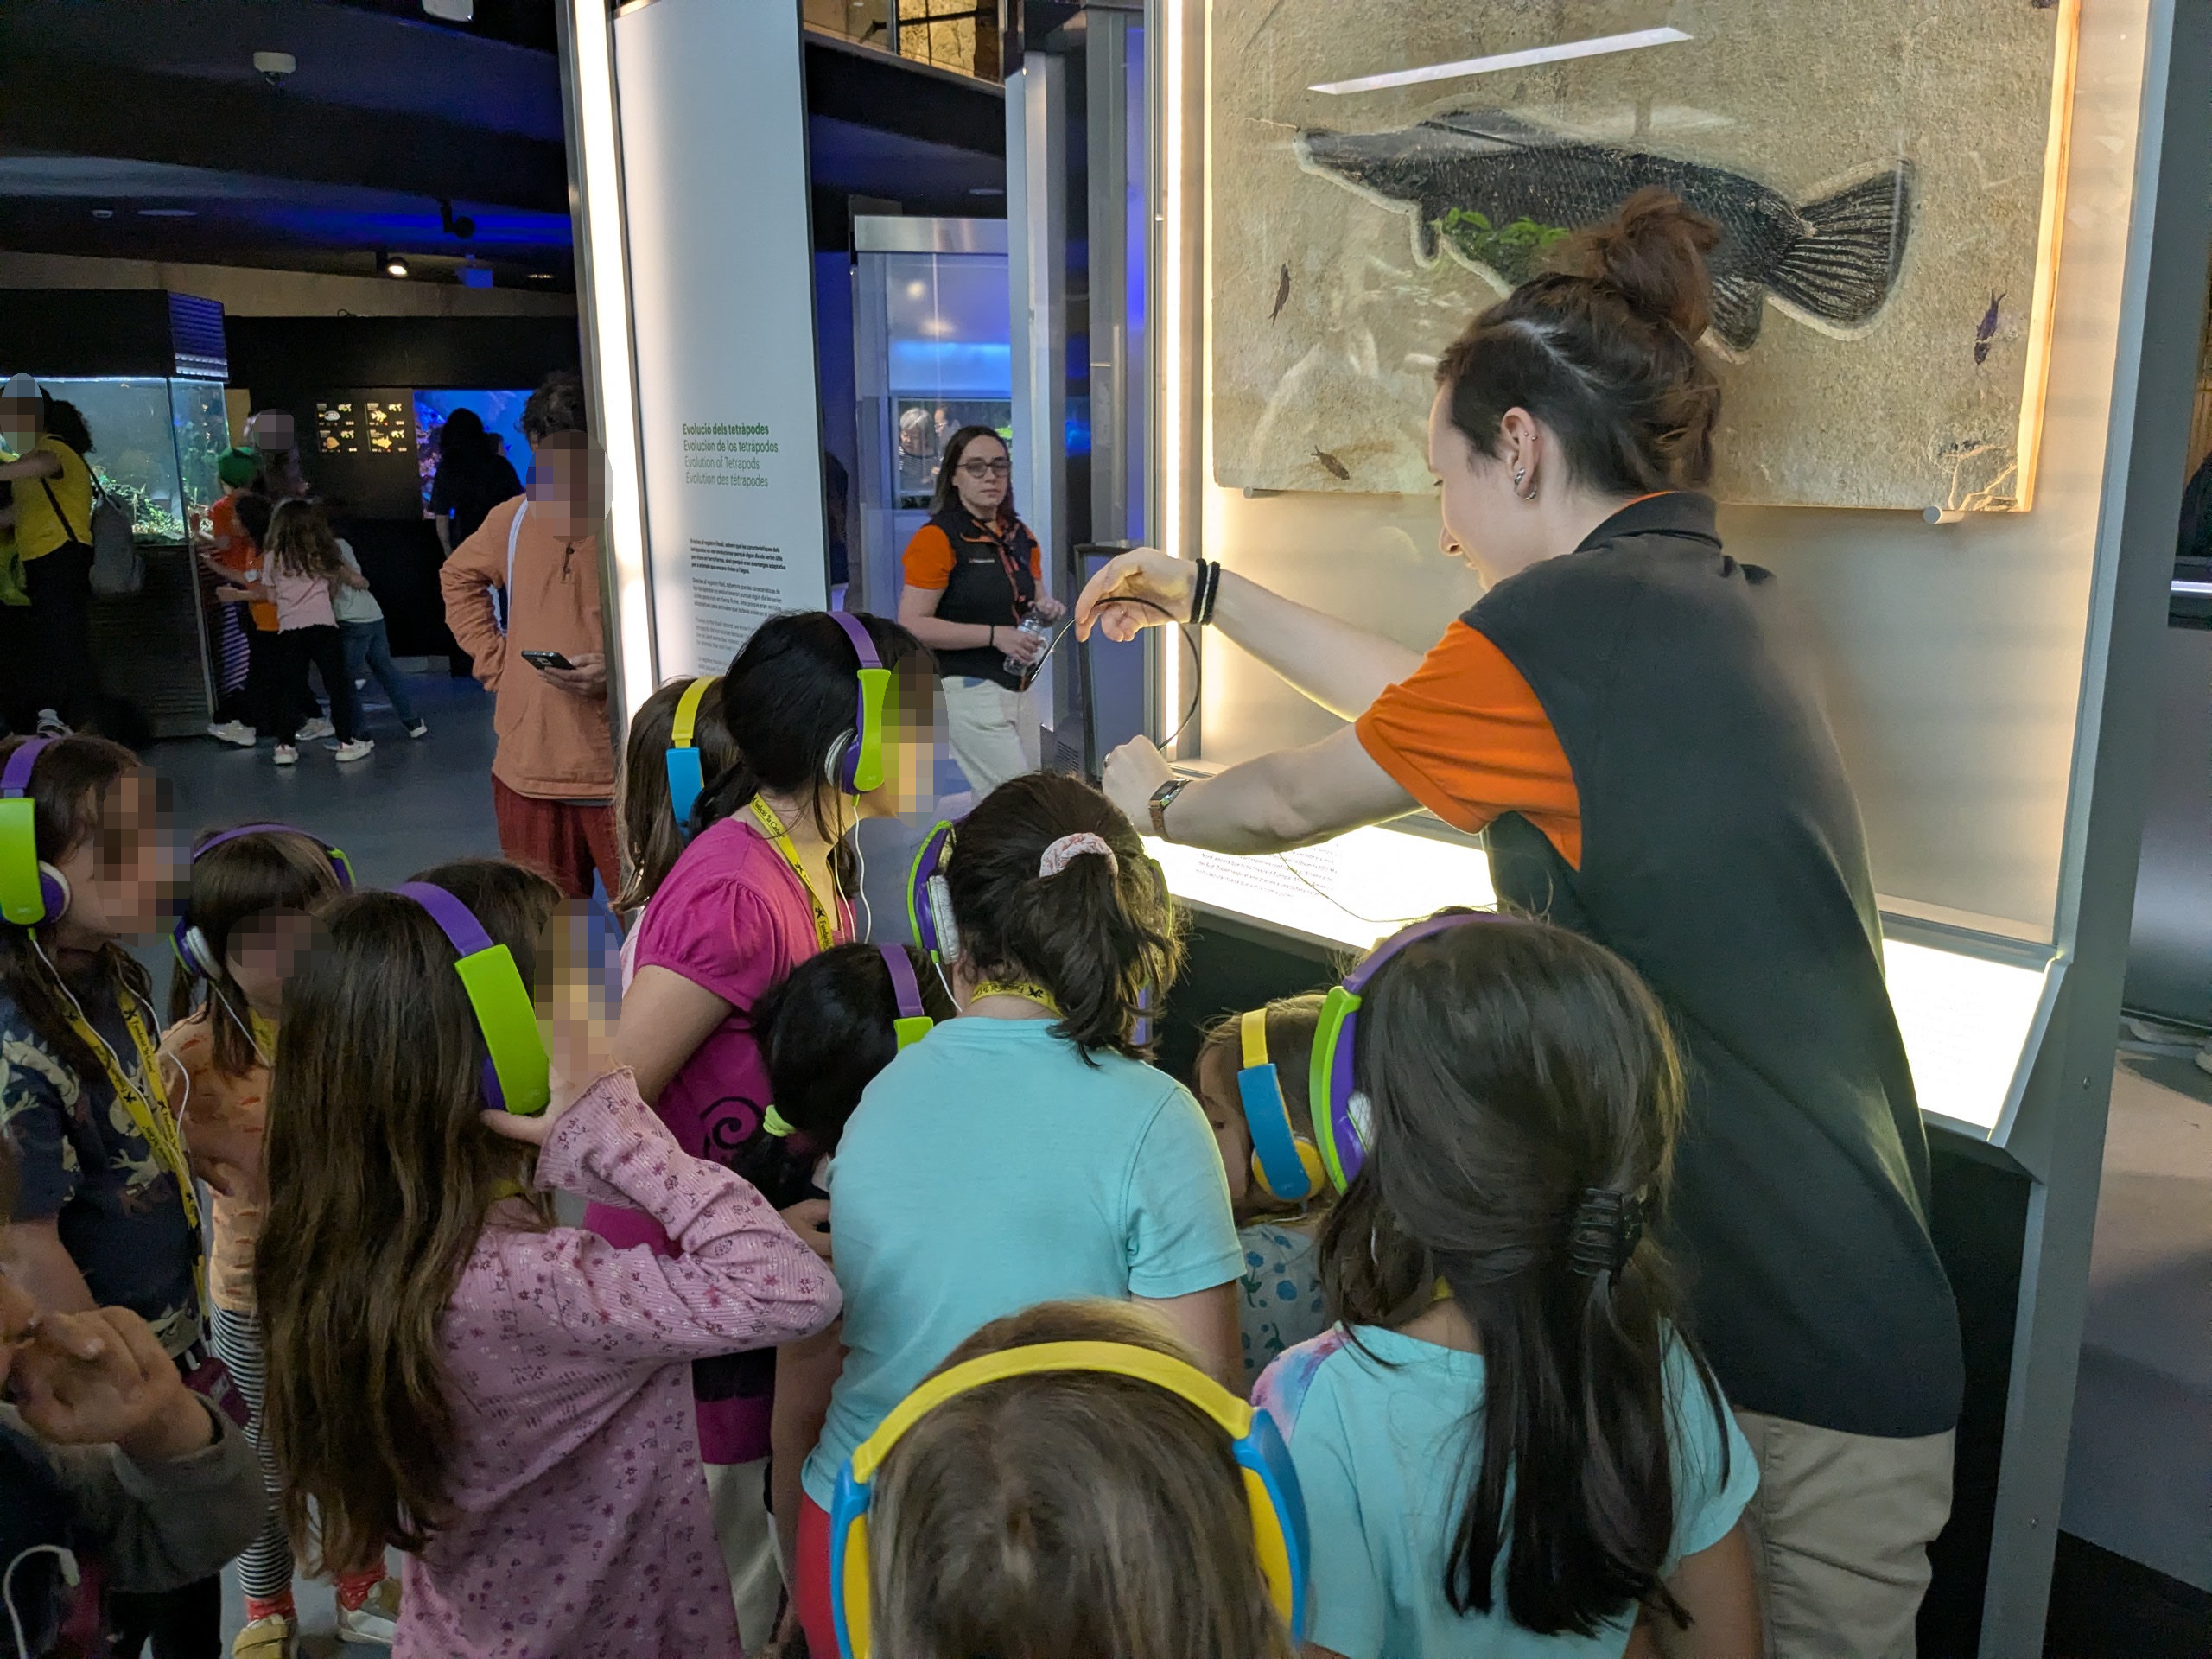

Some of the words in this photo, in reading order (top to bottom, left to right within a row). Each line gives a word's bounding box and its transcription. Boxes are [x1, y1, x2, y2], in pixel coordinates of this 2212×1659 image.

[683, 423, 712, 435] Evolució
[713, 423, 728, 435] dels
[728, 422, 769, 437] tetràpodes
[683, 439, 716, 451] Evolución
[717, 439, 726, 451] de
[727, 439, 737, 452] los
[739, 439, 779, 454] tetrápodos
[685, 455, 715, 468] Evolution
[716, 455, 724, 468] of
[725, 456, 760, 471] Tetrapods
[717, 473, 728, 485] des
